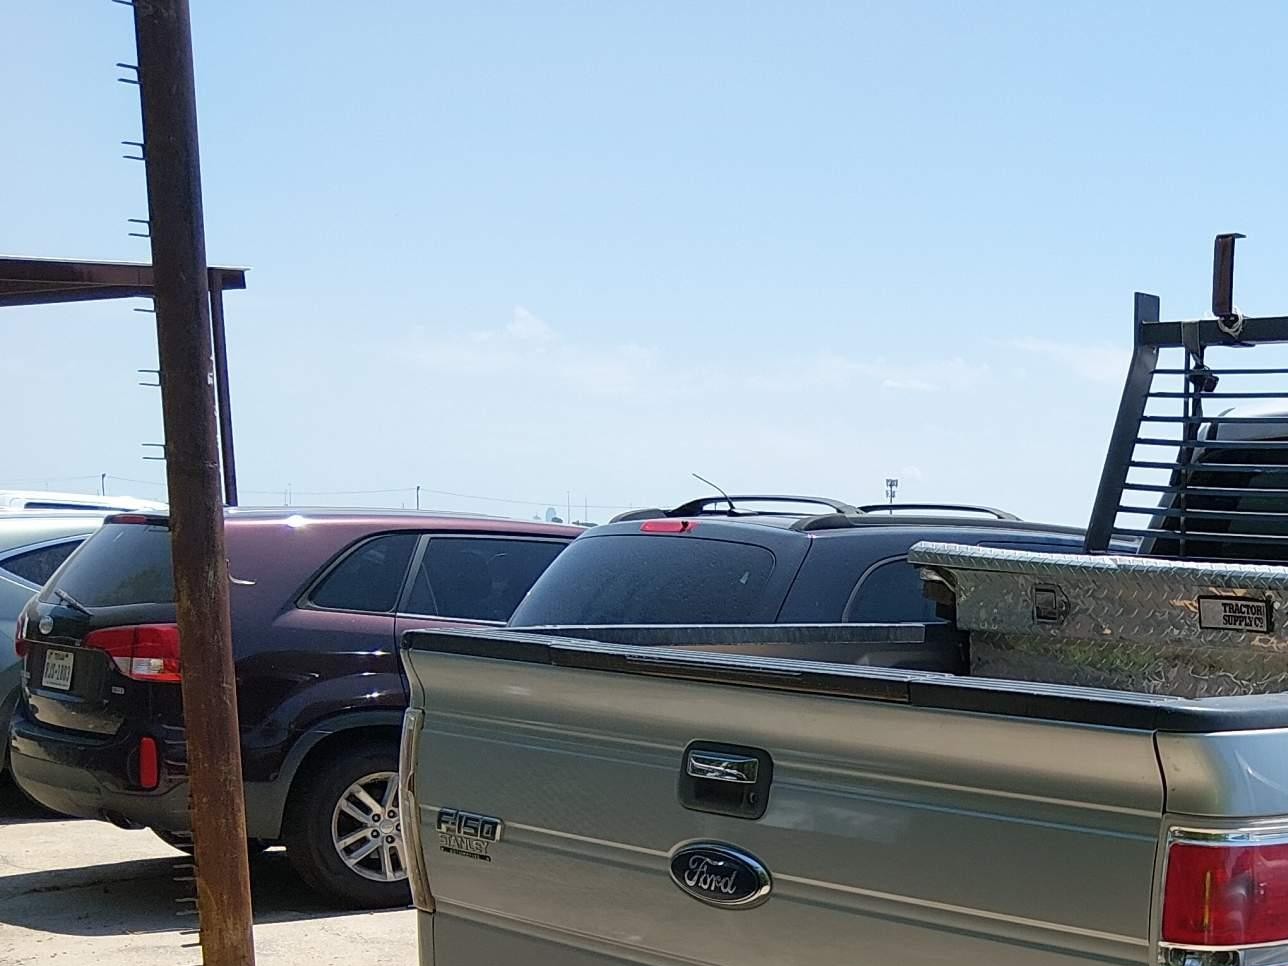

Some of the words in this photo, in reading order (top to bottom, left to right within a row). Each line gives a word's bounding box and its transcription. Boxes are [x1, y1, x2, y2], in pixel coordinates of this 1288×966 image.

[1221, 602, 1262, 616] TRACTOR
[1222, 614, 1253, 627] SUPPLY
[684, 855, 737, 894] Ford
